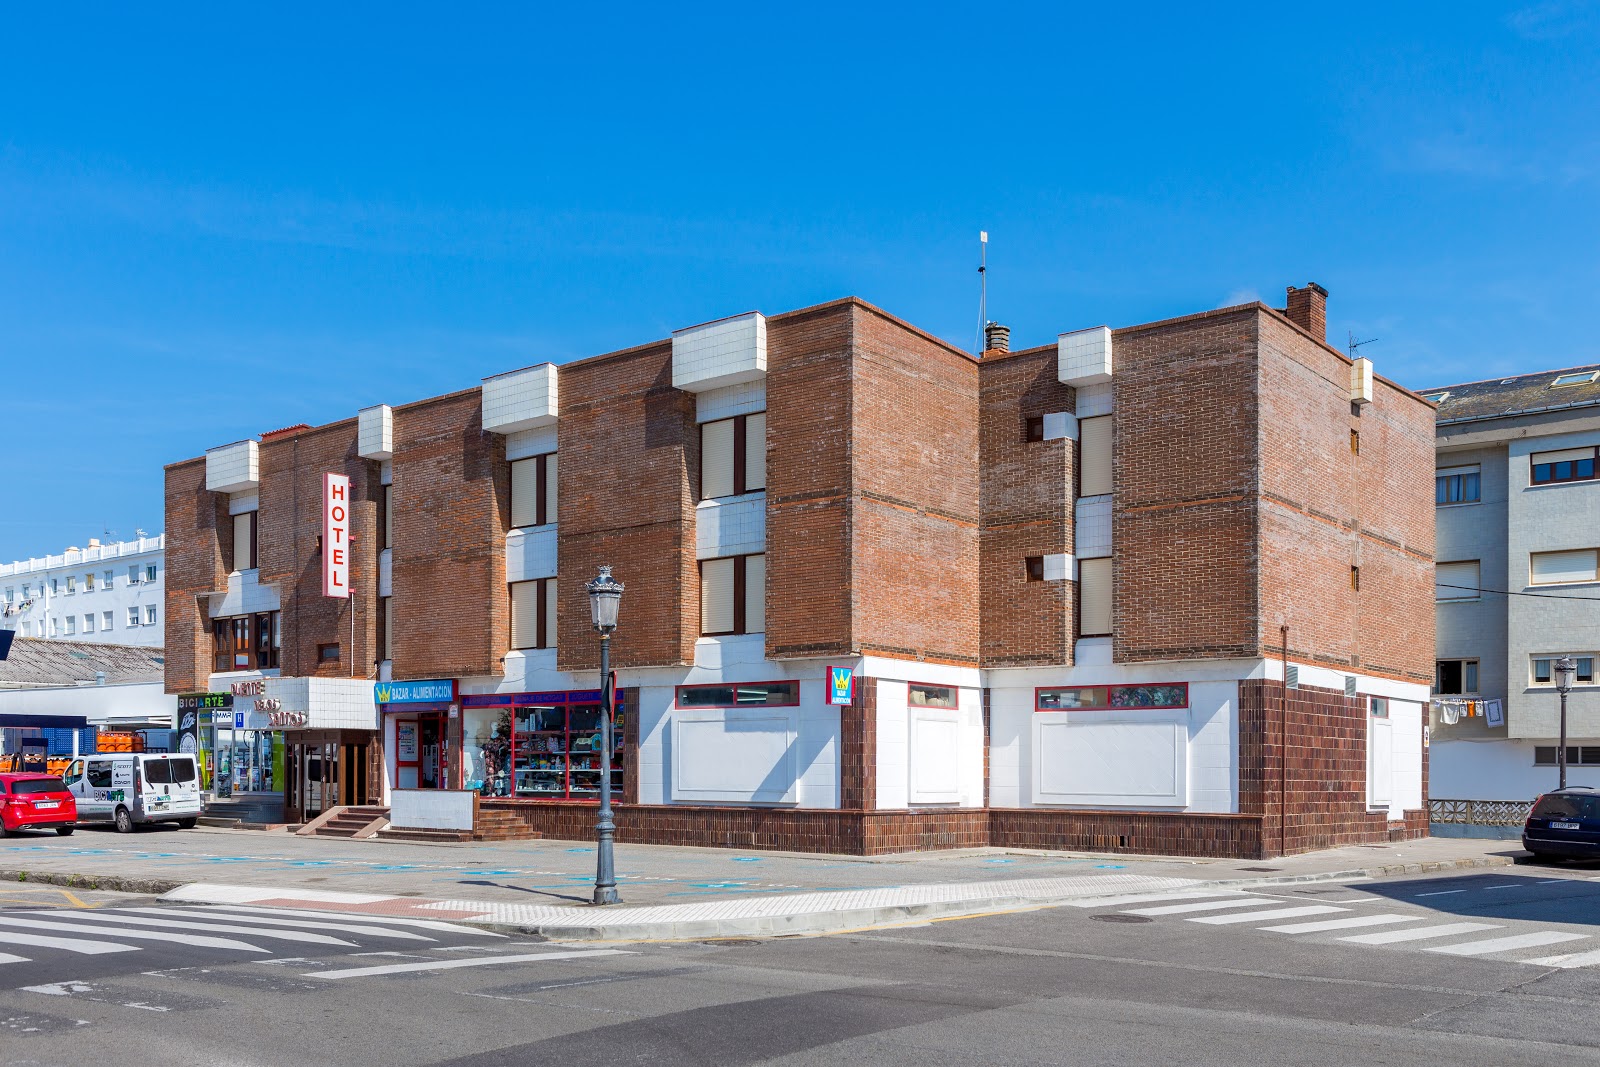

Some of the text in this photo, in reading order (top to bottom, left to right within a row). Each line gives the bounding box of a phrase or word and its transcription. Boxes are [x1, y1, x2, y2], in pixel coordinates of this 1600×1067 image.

[332, 484, 345, 587] HOTEL
[391, 687, 409, 700] BAZAR
[412, 683, 452, 699] ALIMENTACIÓN
[179, 696, 224, 708] BICIARTE
[237, 714, 242, 723] H
[268, 711, 306, 728] SANTOS
